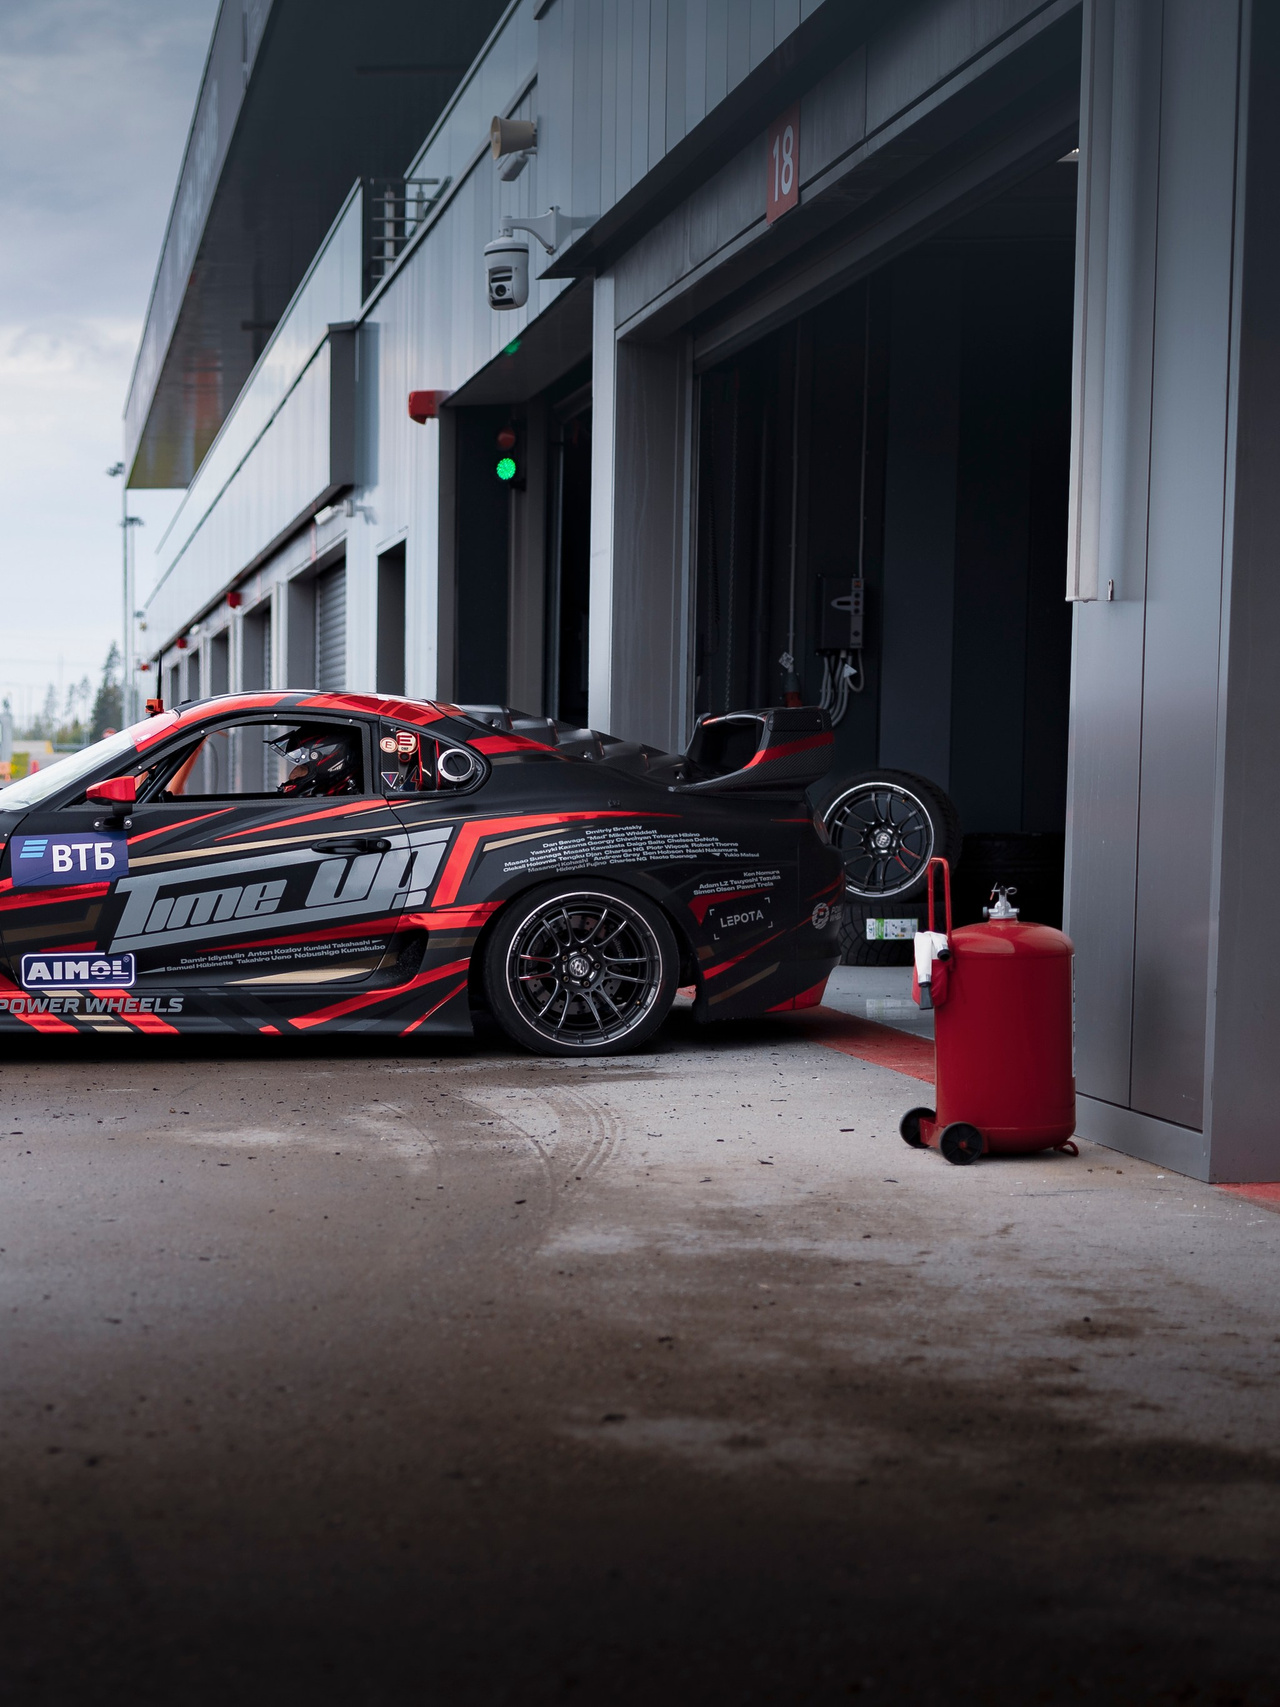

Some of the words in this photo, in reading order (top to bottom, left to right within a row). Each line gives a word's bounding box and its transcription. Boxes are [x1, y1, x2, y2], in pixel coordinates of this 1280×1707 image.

[773, 125, 793, 202] 18
[558, 842, 587, 850] Kazama
[52, 842, 116, 873] ВТБ
[504, 859, 529, 867] Masao
[530, 852, 561, 861] Suenaga
[720, 909, 764, 928] LEPOTA
[332, 940, 371, 948] Takahashi
[166, 964, 196, 972] Samuel
[294, 950, 340, 959] Nobushige
[341, 945, 386, 954] Kumakubo
[27, 960, 129, 981] AIMOL
[86, 998, 184, 1013] WHEELS
